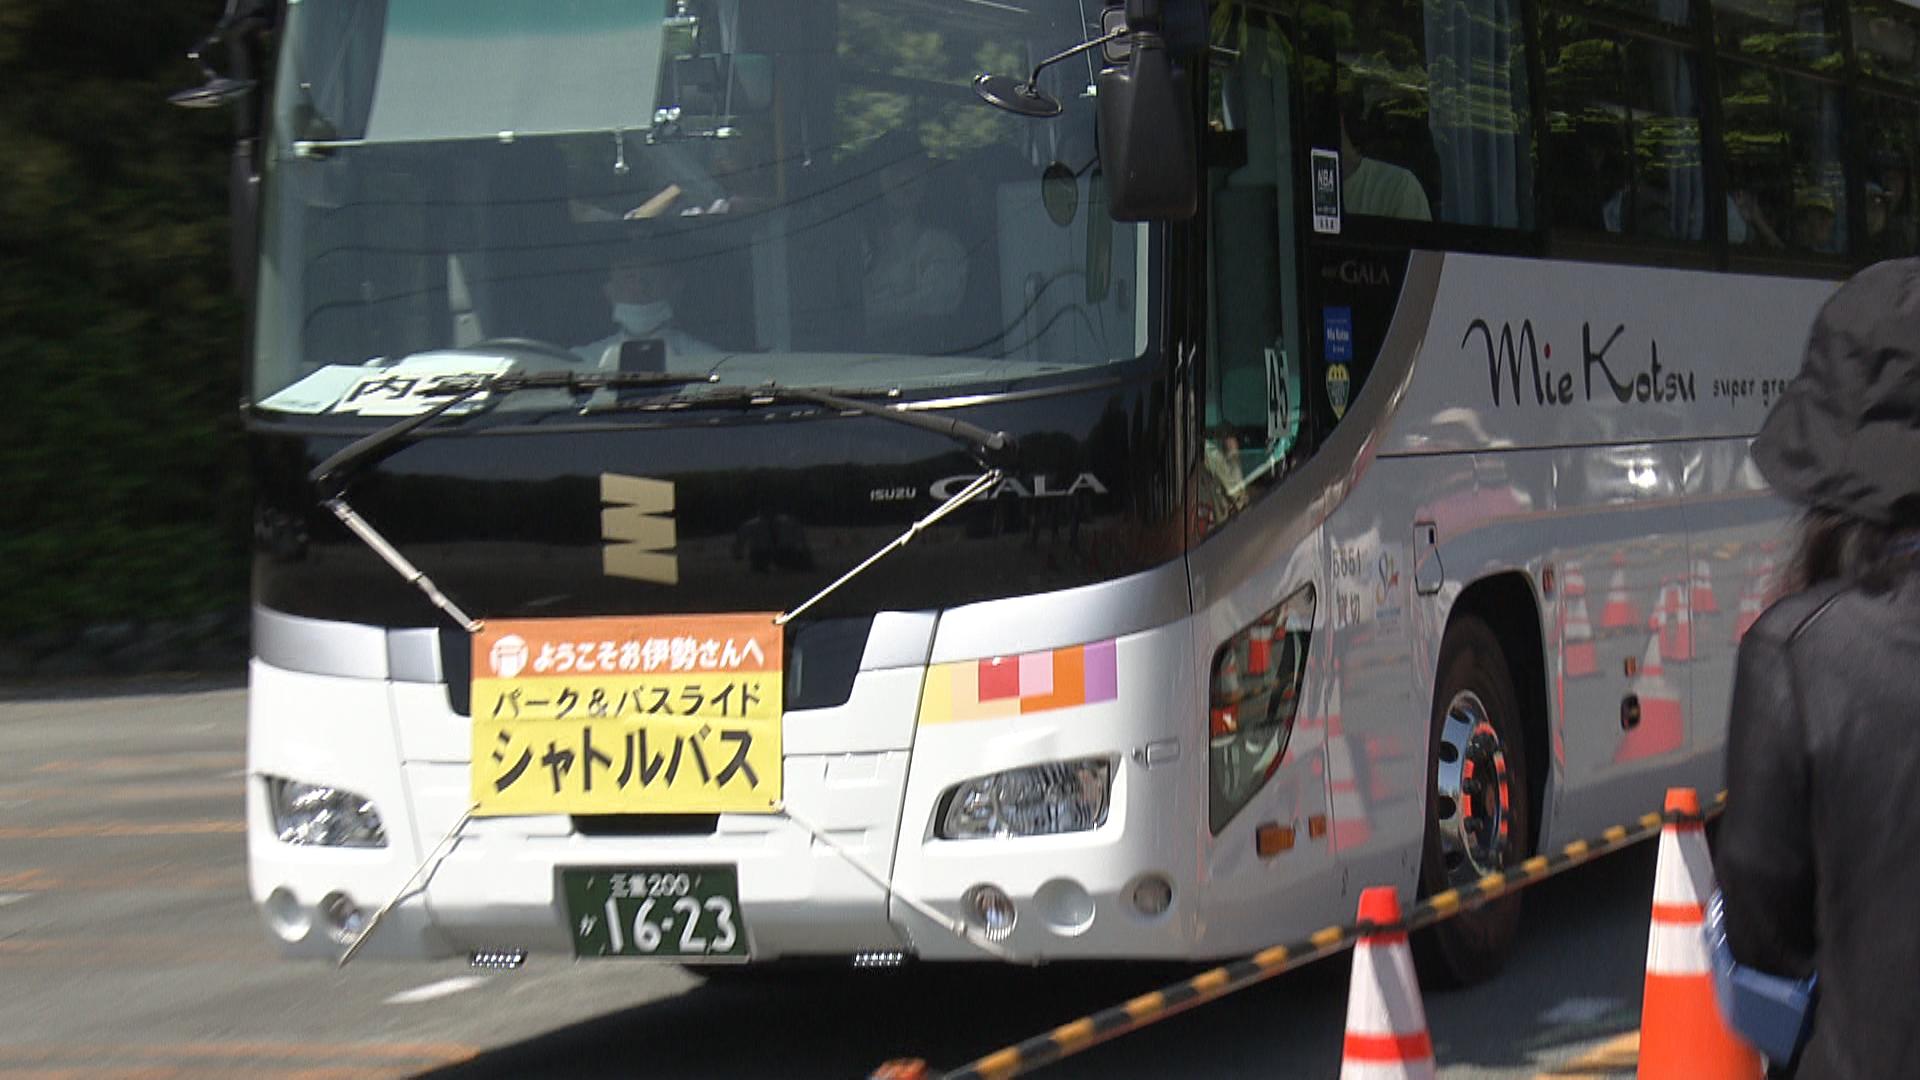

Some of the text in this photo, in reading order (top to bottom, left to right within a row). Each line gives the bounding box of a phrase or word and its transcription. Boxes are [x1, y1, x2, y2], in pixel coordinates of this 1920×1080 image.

[1270, 353, 1289, 430] 45
[1461, 318, 1574, 408] Mie
[1582, 321, 1697, 404] Kotsu
[870, 473, 1108, 502] ISUZU GALA
[533, 637, 764, 671] ようこそお伊勢さんへ
[491, 724, 760, 794] シャトルバス
